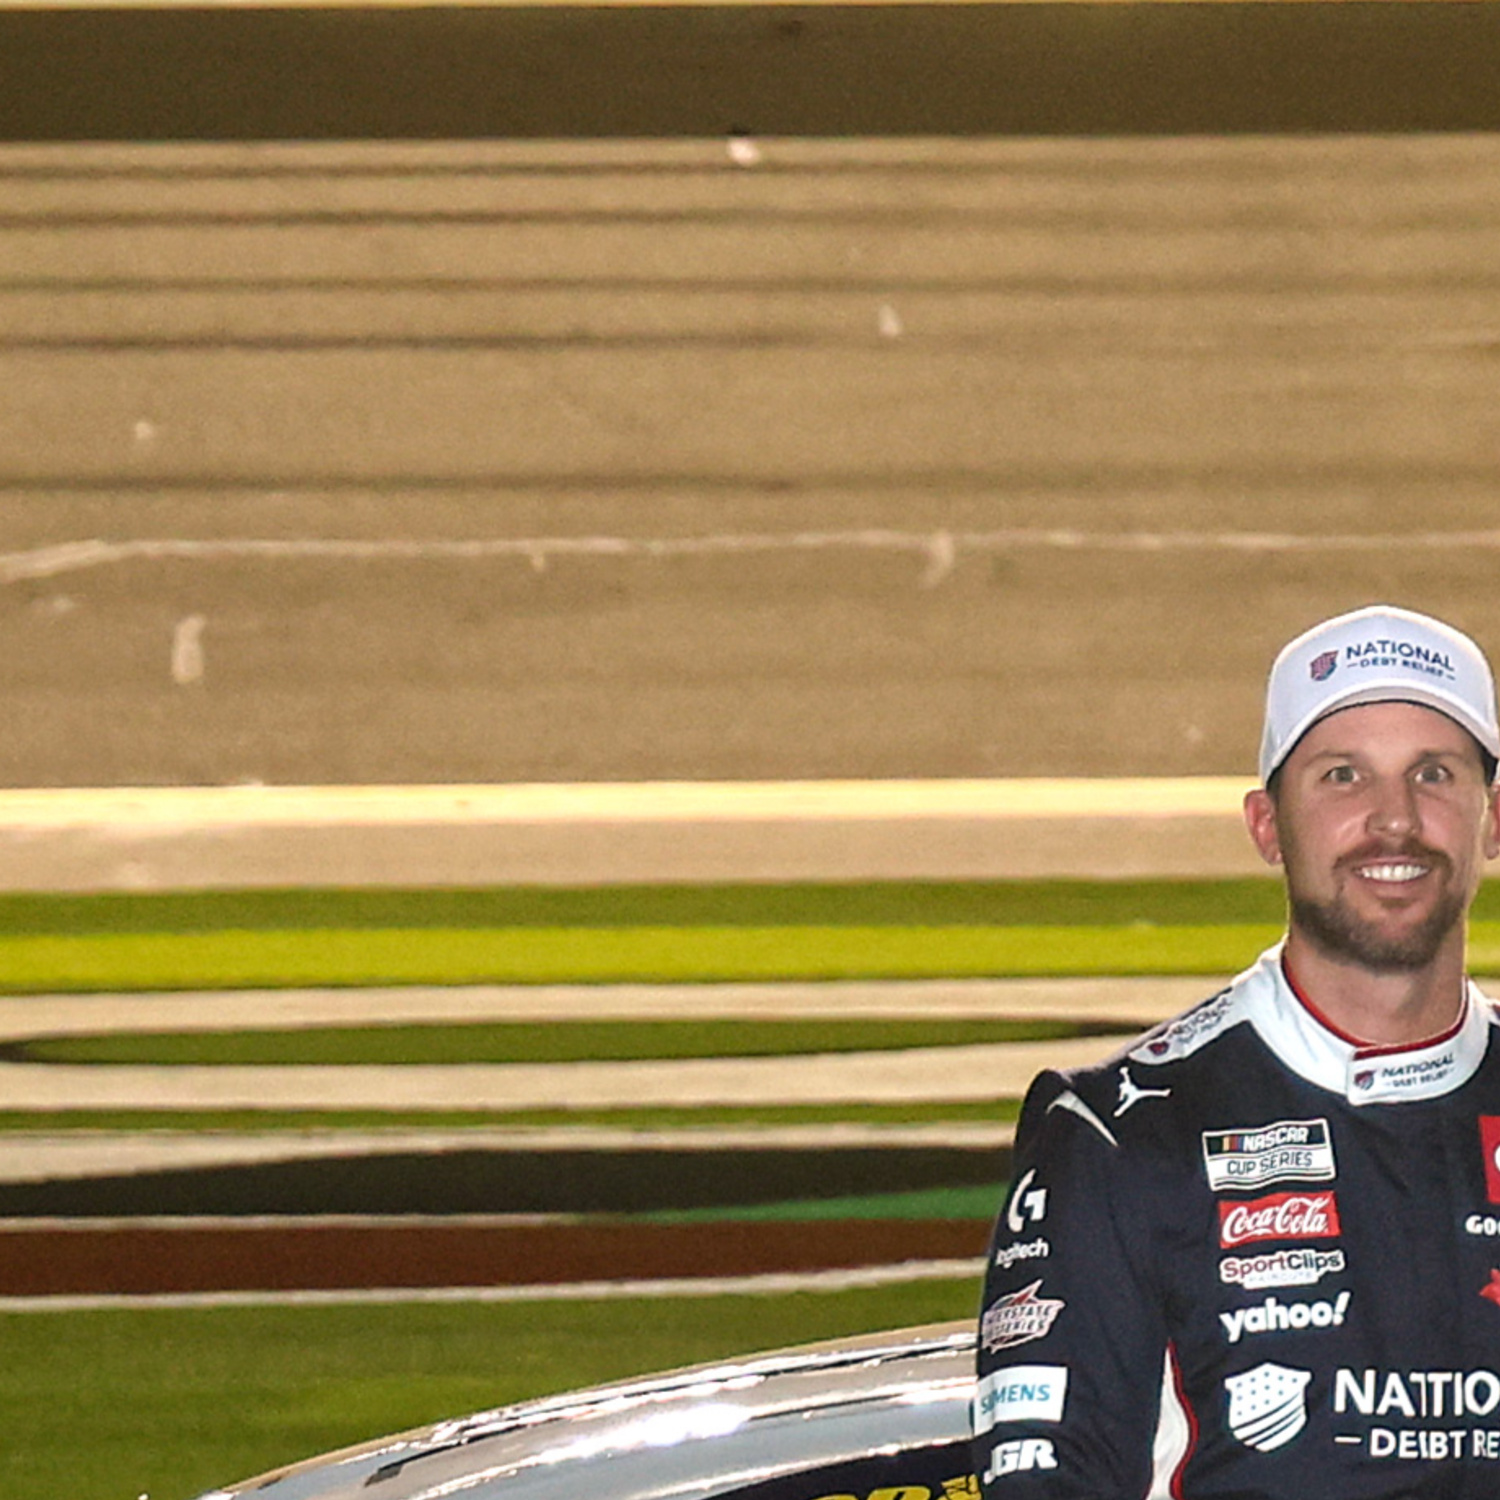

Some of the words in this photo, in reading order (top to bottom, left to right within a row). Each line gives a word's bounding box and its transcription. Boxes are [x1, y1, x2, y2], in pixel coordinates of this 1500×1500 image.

[1346, 640, 1455, 672] NATIONAL
[1360, 656, 1397, 668] DEBT
[1402, 661, 1444, 679] RELIEF
[1382, 1053, 1453, 1078] NATIONAL
[1244, 1127, 1308, 1151] NASCAR
[1227, 1160, 1256, 1175] CUP
[1260, 1152, 1313, 1172] SERIES
[1222, 1197, 1331, 1243] Coca-Cola
[985, 1305, 1052, 1326] ERSTATE
[1220, 1292, 1351, 1342] yahoo!
[981, 1384, 1051, 1415] SIMENS
[1369, 1428, 1467, 1460] DEBT
